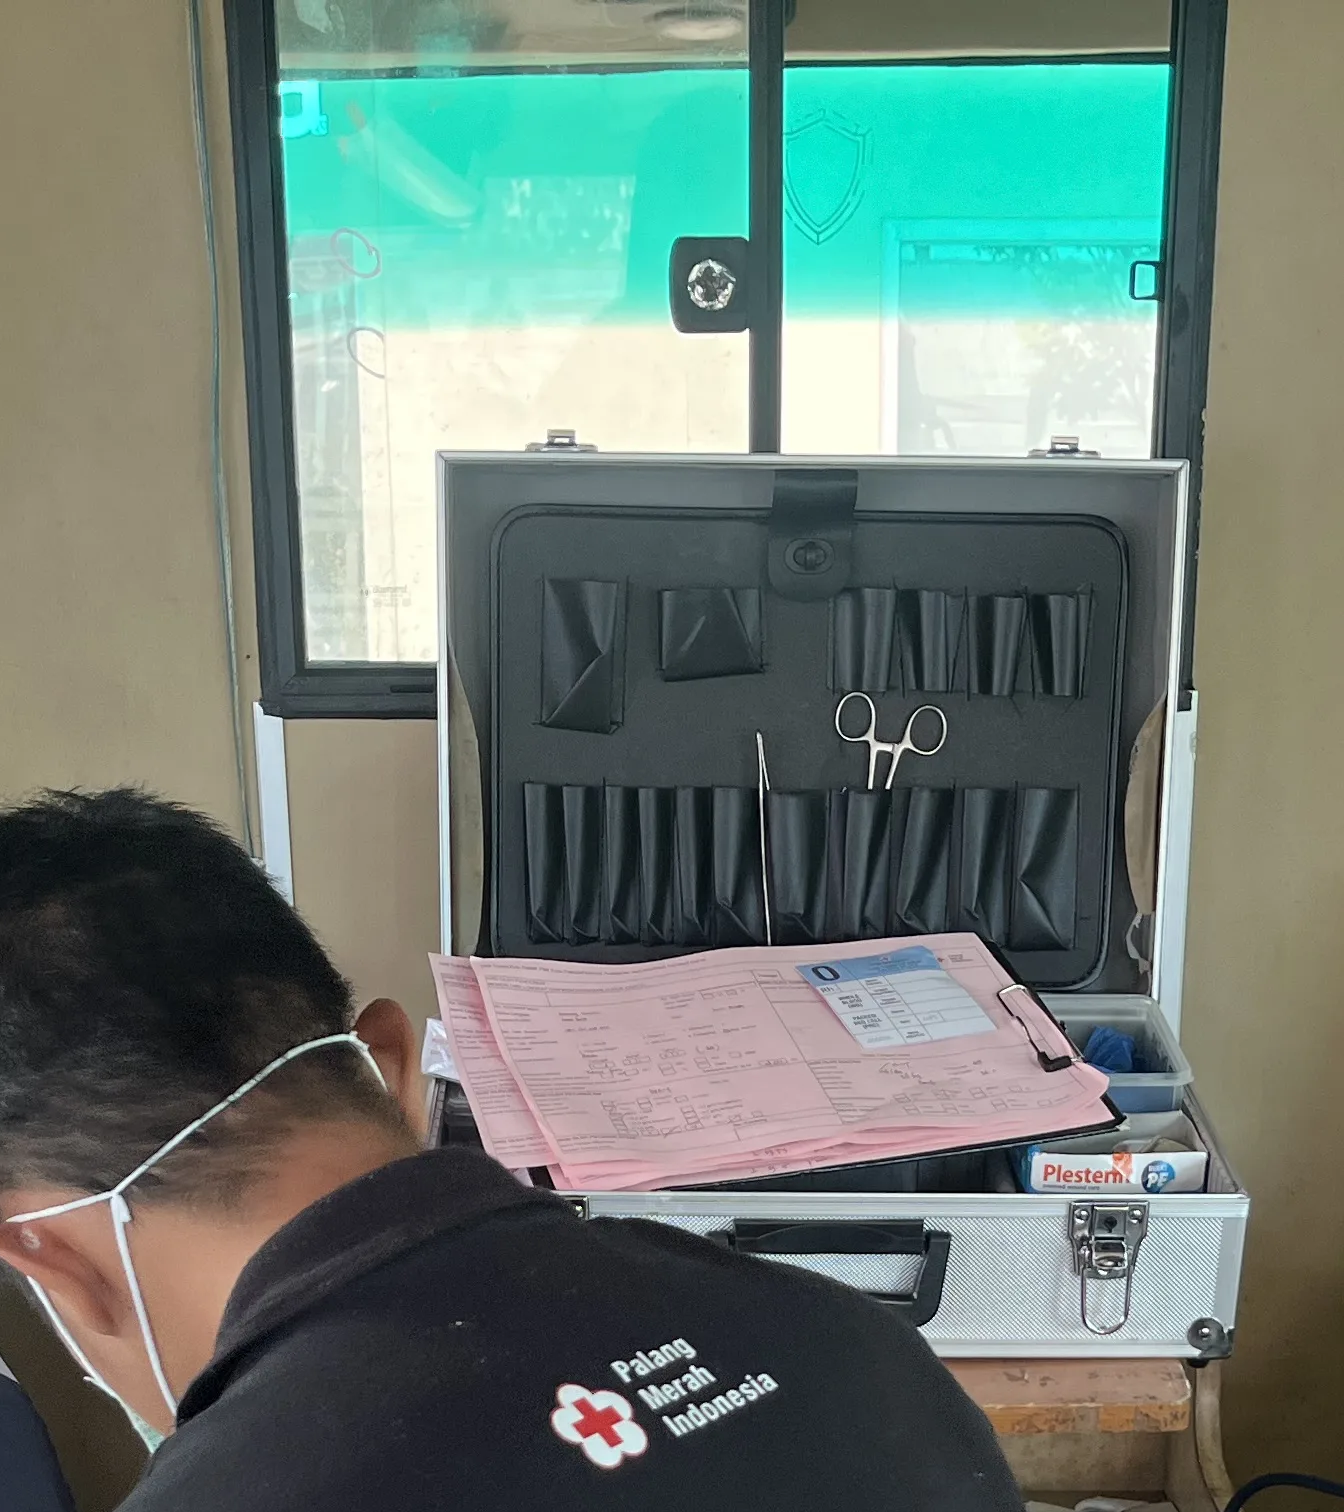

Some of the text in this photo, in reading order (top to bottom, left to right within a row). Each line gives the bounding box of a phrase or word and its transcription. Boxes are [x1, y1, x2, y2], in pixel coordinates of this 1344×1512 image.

[610, 1337, 697, 1384] Palang
[637, 1364, 717, 1411] Merah
[662, 1373, 780, 1437] Indonesia
